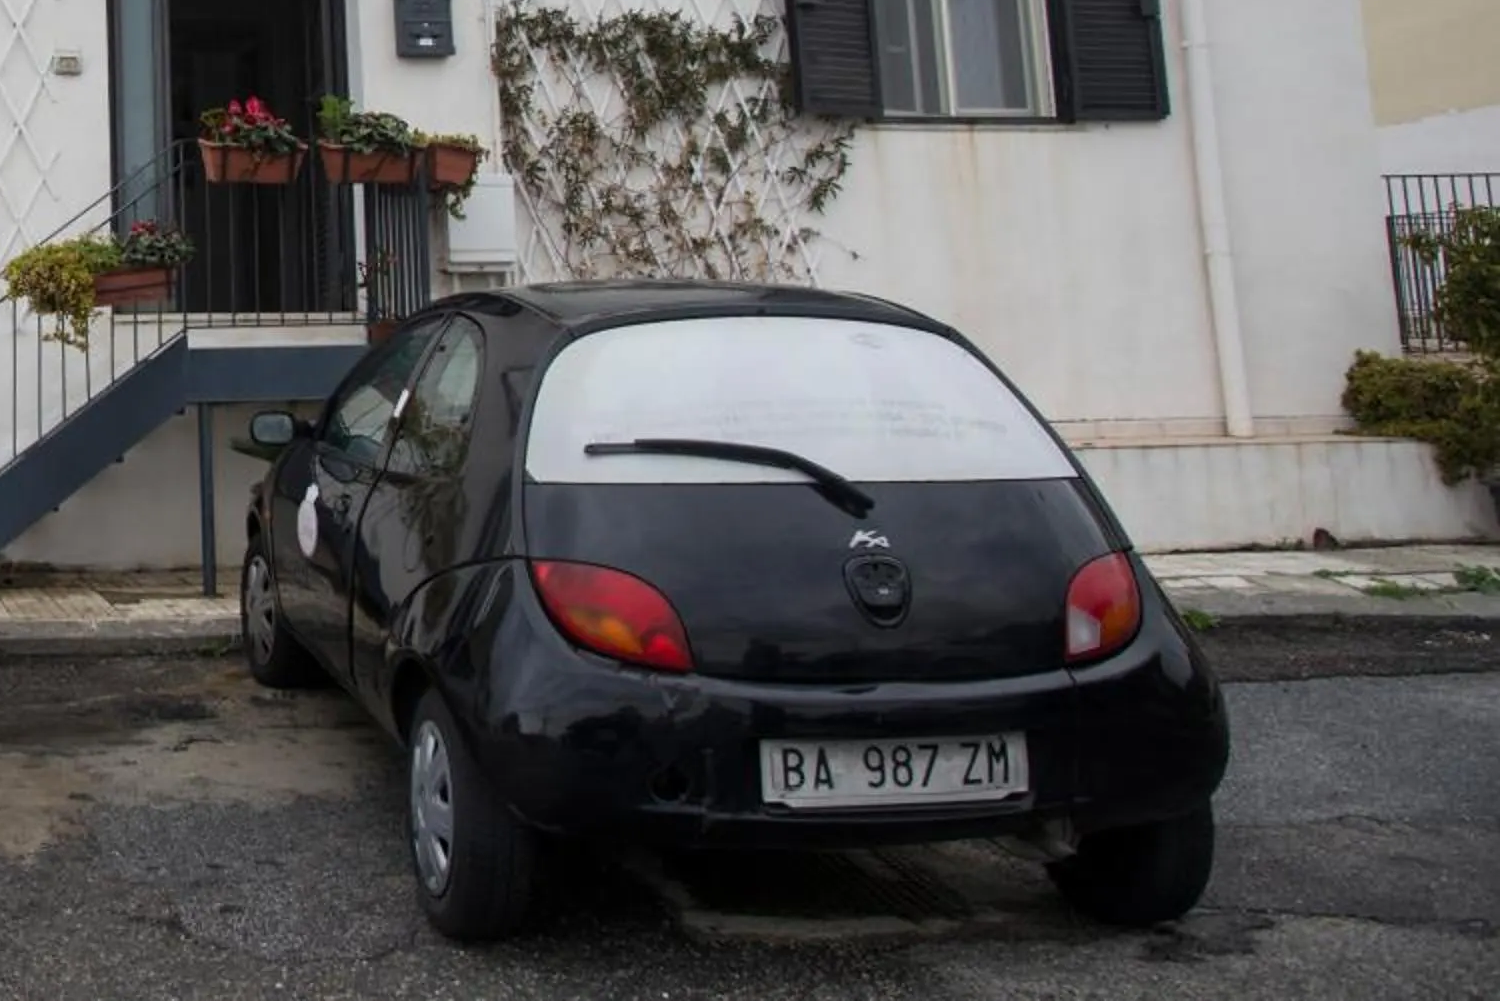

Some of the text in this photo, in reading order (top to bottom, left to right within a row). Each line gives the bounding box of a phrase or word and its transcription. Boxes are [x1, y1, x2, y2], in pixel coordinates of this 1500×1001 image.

[781, 741, 1010, 791] BA 987 ZM
